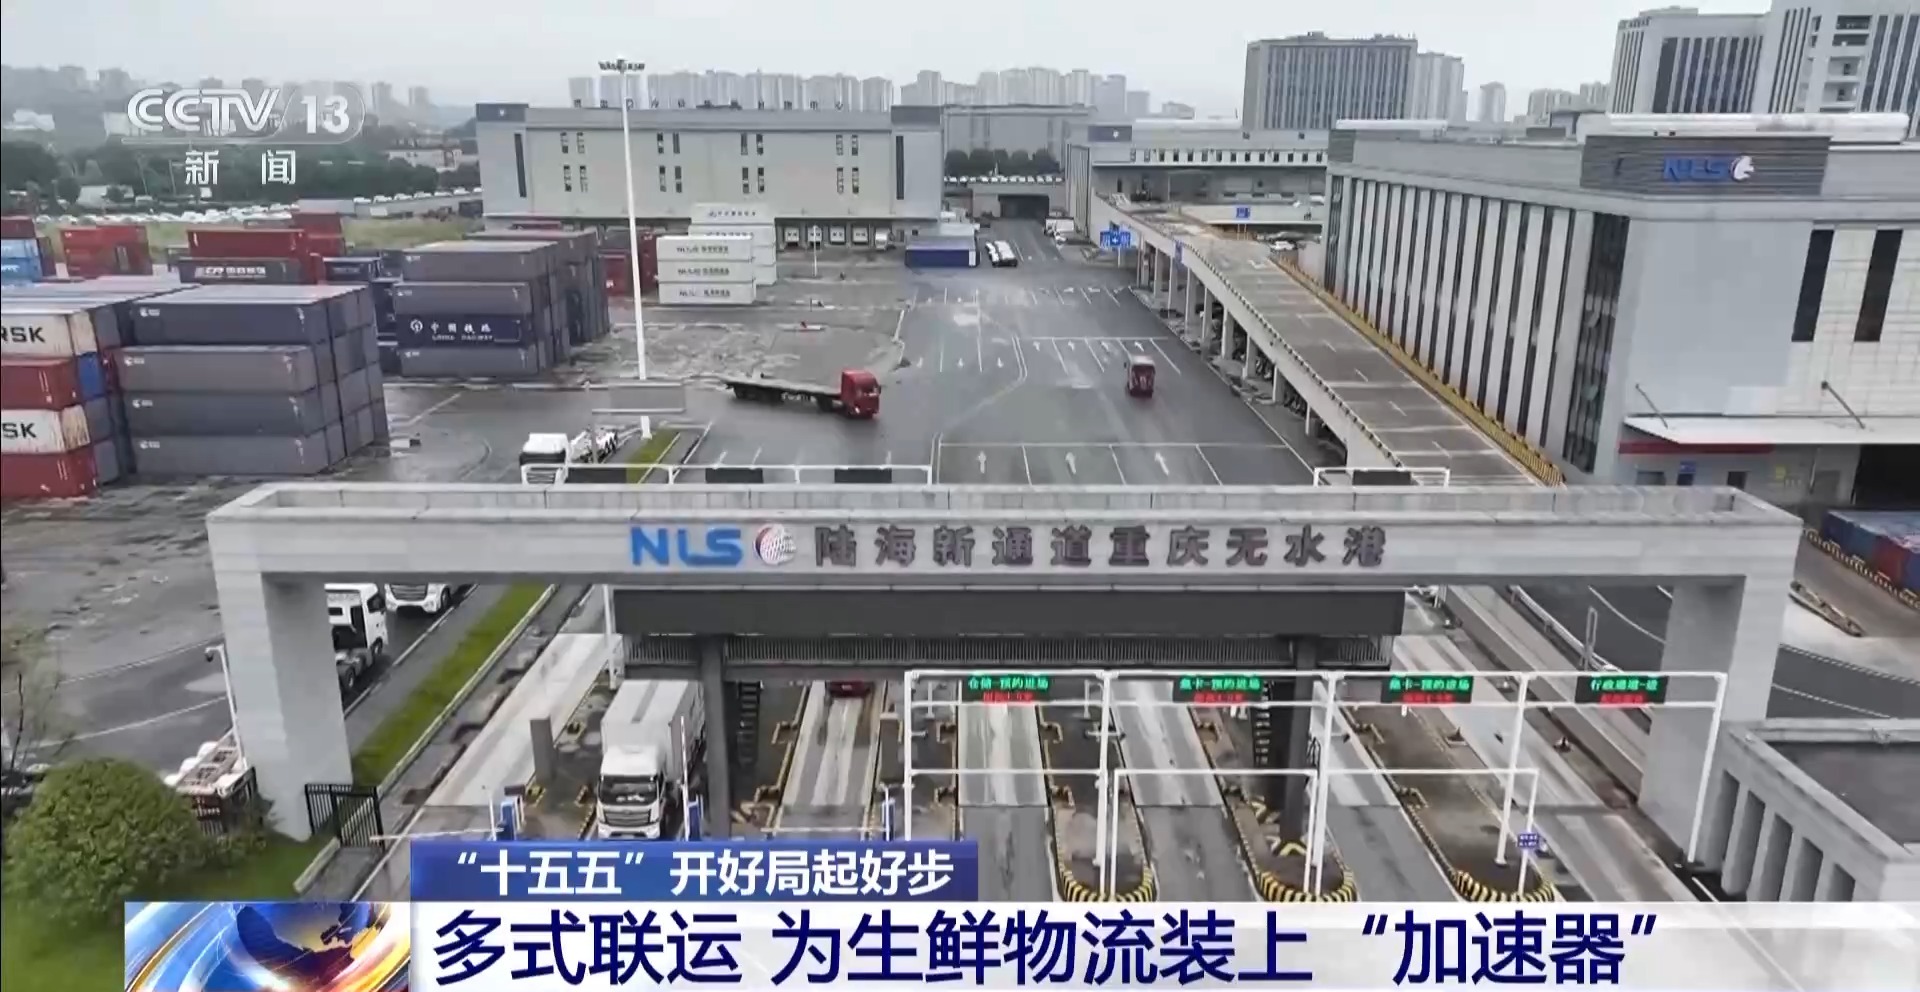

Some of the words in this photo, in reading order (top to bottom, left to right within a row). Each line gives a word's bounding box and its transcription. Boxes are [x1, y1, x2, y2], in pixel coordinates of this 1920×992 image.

[630, 527, 742, 567] NLS
[814, 524, 1386, 568] 陆海新通道重庆无水港
